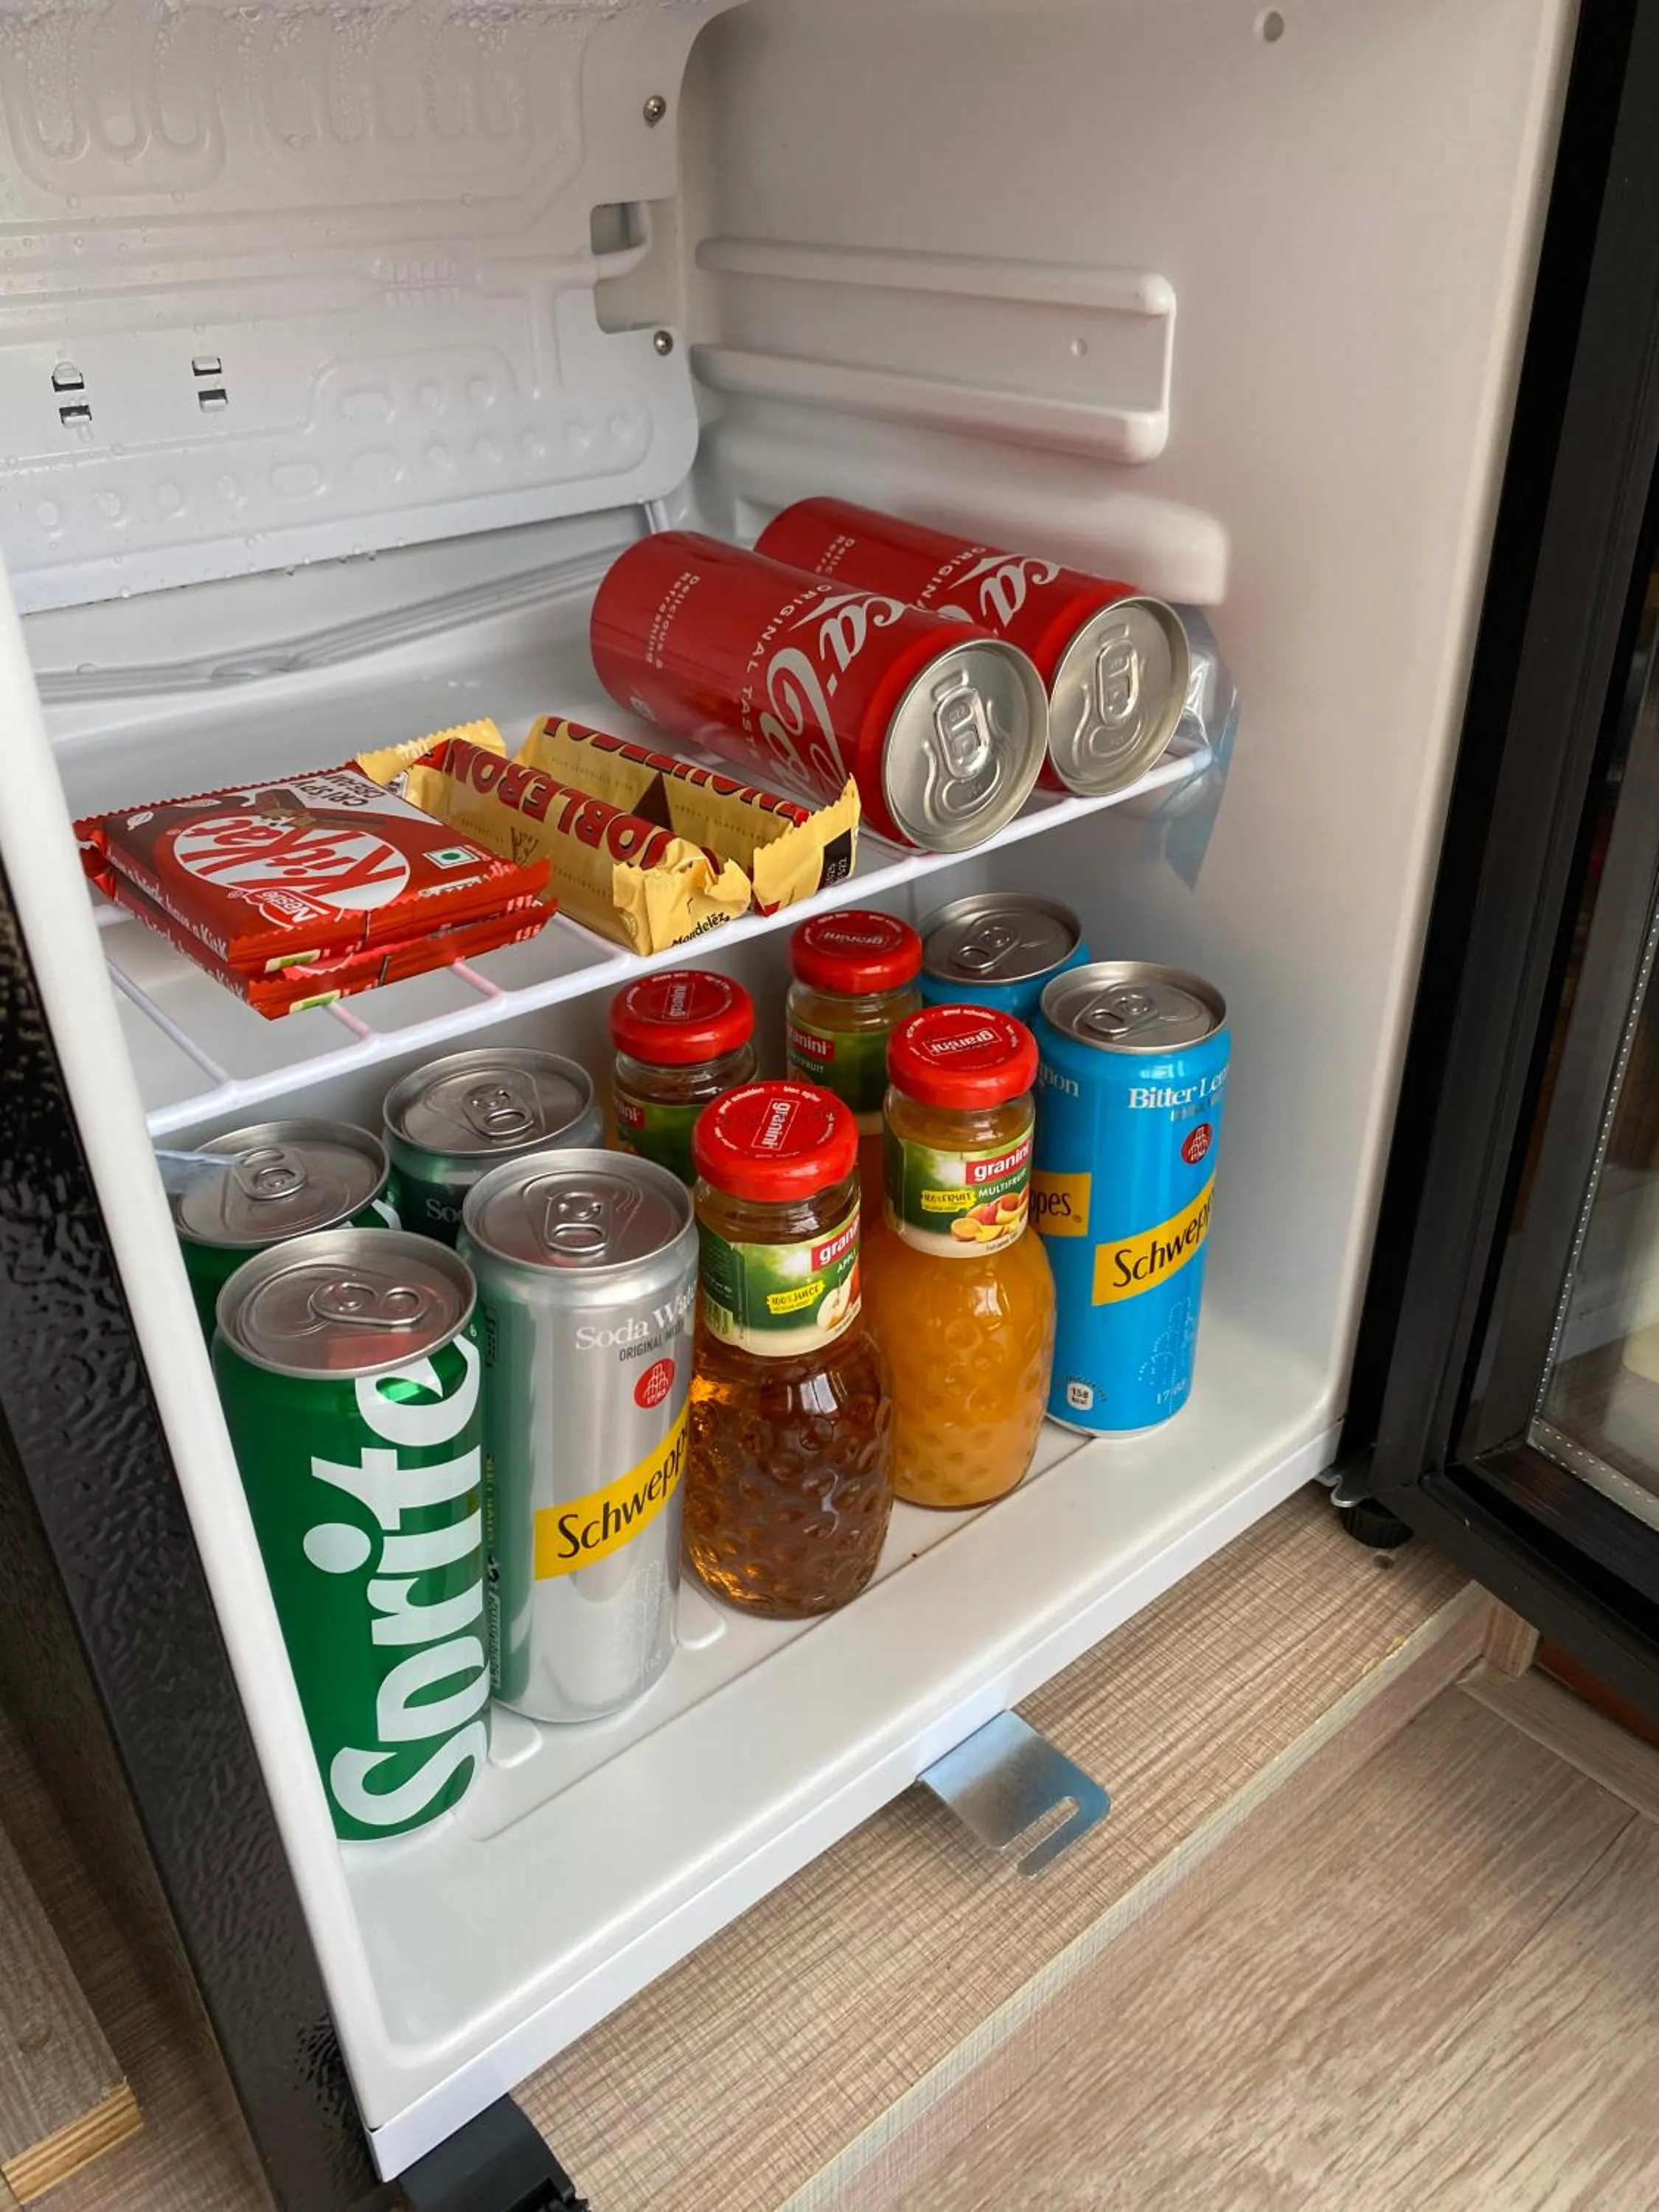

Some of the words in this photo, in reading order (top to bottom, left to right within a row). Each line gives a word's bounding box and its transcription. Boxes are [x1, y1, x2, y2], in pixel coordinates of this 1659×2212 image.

[917, 547, 987, 608] ORIGIN
[646, 571, 692, 664] Refreshing
[657, 575, 701, 652] Delicious
[746, 584, 832, 673] ORIGINAL
[444, 737, 682, 872] OBLERON
[931, 1029, 995, 1054] granini
[1039, 1063, 1081, 1098] mon
[1128, 1085, 1198, 1109] Bitter
[761, 1102, 791, 1149] granini
[837, 1246, 857, 1274] APPL
[574, 1317, 650, 1350] Soda
[618, 1335, 663, 1363] ORIGINAL
[557, 1419, 690, 1558] Schwepp
[303, 1334, 490, 1826] Sprite
